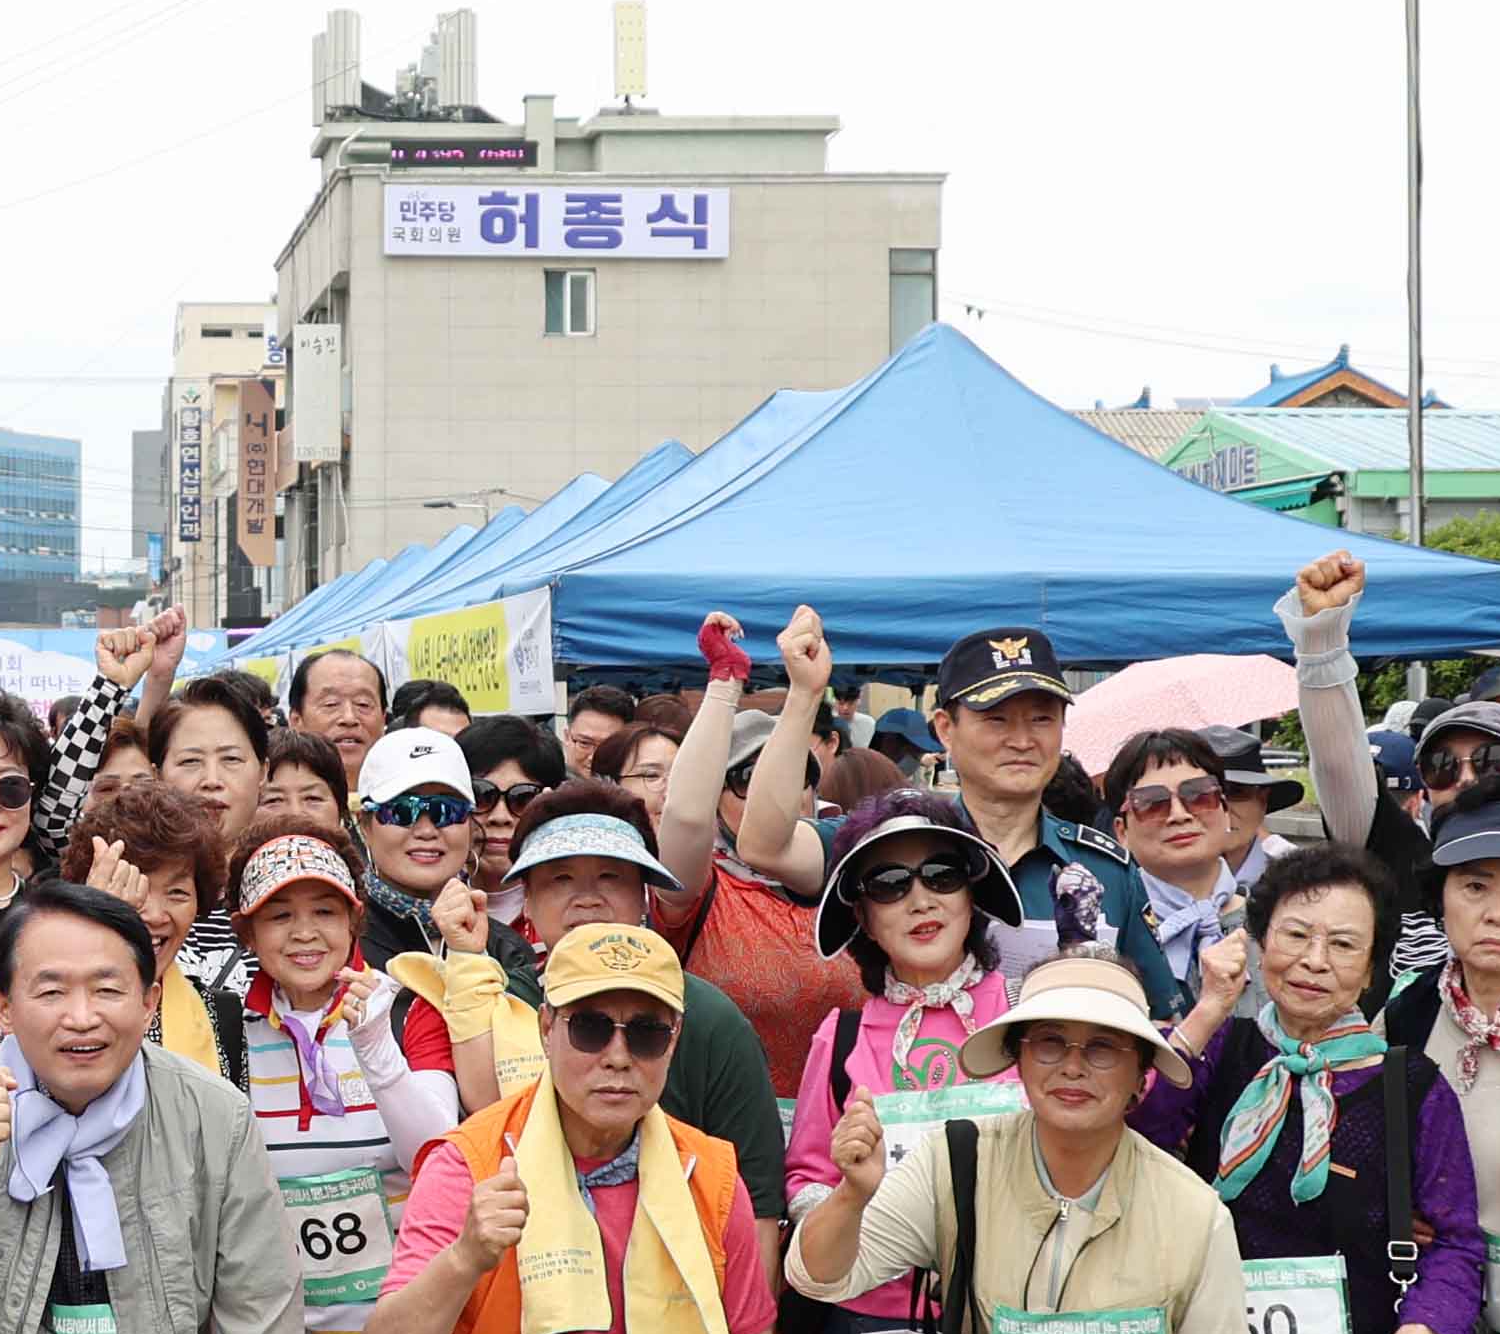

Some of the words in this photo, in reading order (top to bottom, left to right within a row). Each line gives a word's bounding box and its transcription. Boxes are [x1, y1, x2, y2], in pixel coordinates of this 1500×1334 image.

[399, 200, 456, 224] 민주당
[478, 190, 709, 250] 허종식
[392, 226, 461, 244] 국회의원
[30, 674, 83, 694] 떠나는
[296, 1212, 367, 1261] 68
